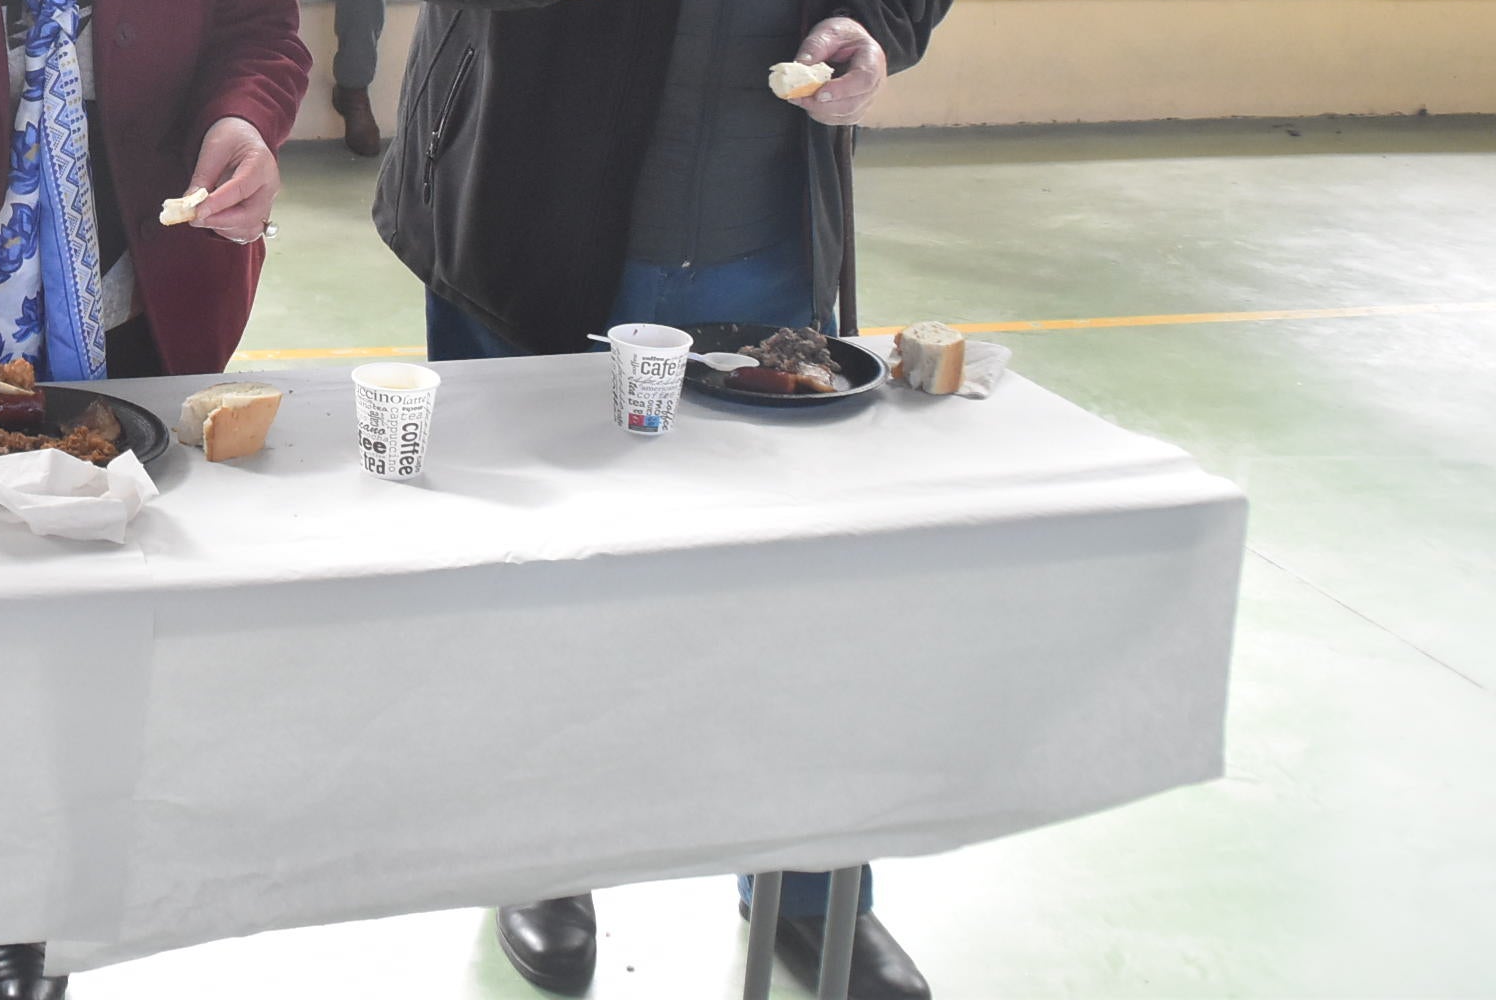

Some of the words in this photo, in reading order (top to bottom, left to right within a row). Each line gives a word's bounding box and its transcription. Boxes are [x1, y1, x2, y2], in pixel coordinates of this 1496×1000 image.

[640, 359, 677, 379] cafe
[399, 422, 420, 476] coffee
[364, 452, 386, 475] tea
